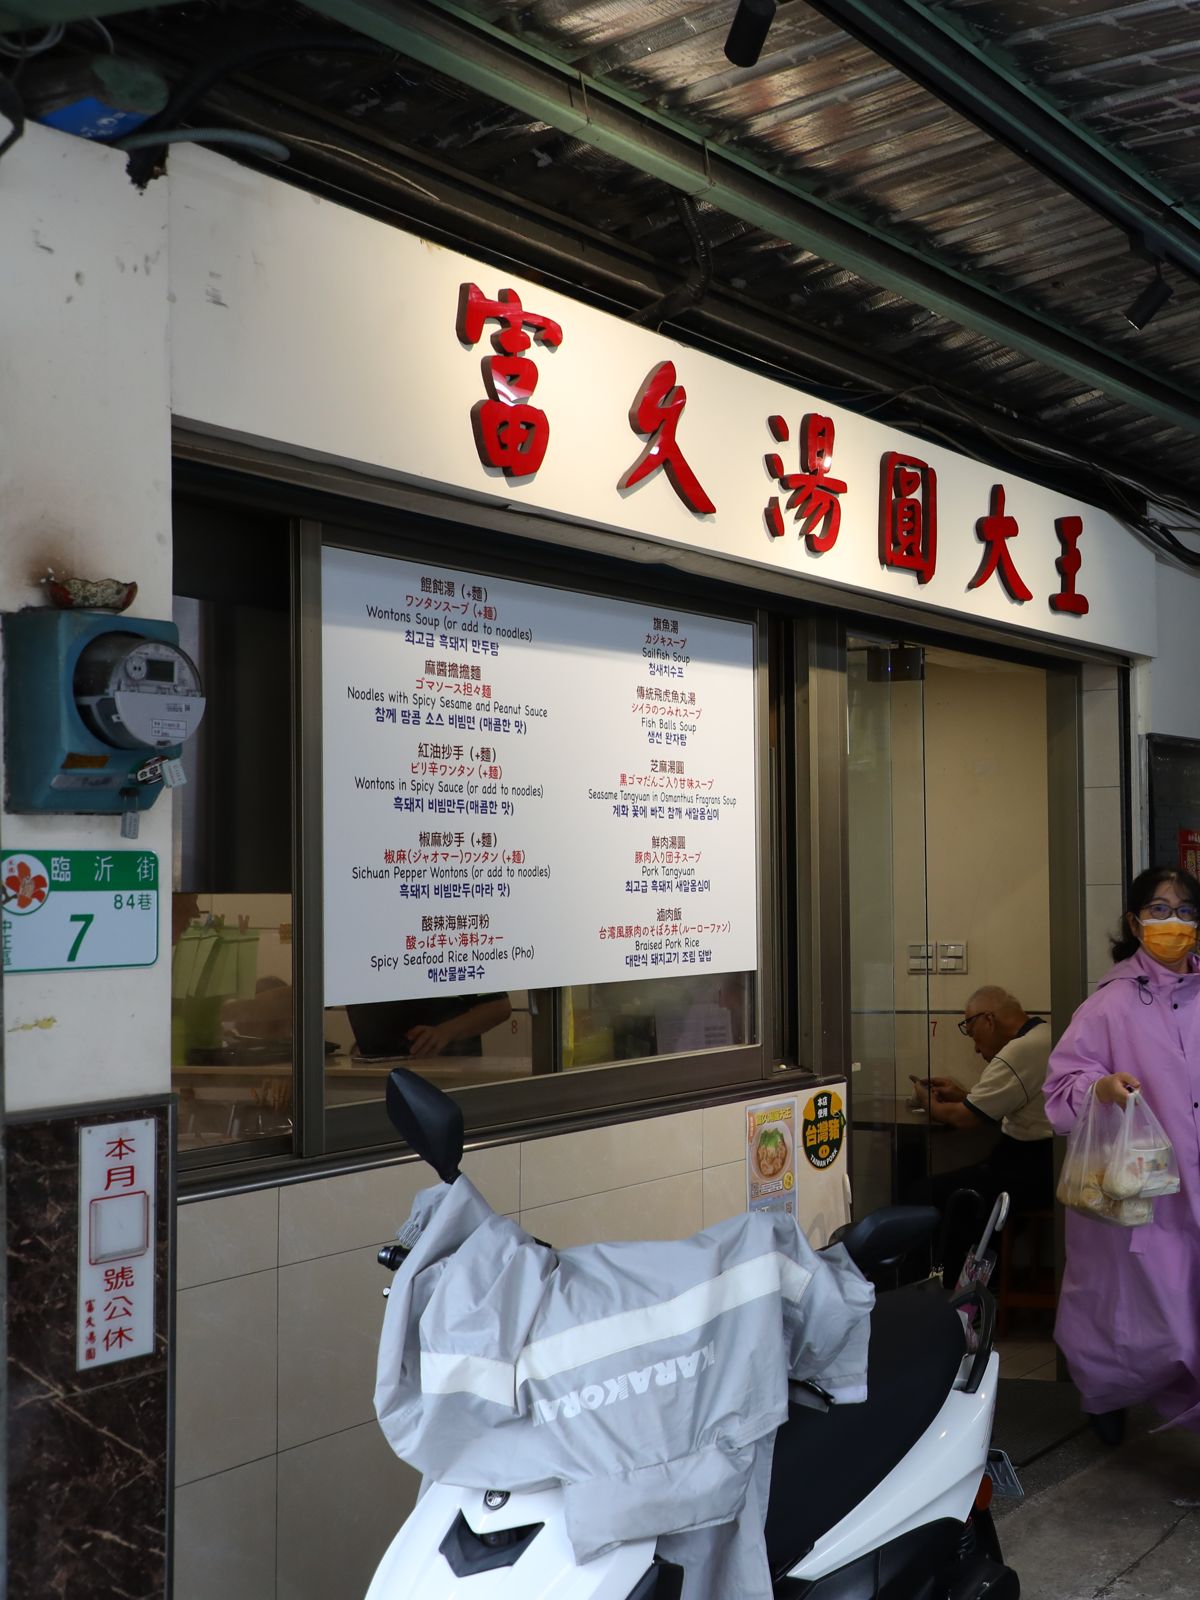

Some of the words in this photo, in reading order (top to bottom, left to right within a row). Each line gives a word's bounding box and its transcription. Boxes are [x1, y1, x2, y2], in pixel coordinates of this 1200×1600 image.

[455, 281, 1090, 616] 富久湯圓大王
[420, 576, 455, 598] 餛飩湯
[405, 595, 469, 615] ワンタンスープ
[366, 604, 411, 623] Wontons
[415, 614, 440, 628] Soup
[443, 616, 457, 631] (or
[461, 620, 478, 633] add
[483, 624, 492, 635] to
[495, 627, 533, 643] noodles)
[653, 616, 679, 634] 旗魚湯
[404, 629, 435, 648] 최고급
[439, 634, 468, 652] 흑돼지
[471, 639, 499, 657] 만두탕
[642, 647, 670, 661] Sailfish
[672, 652, 691, 666] Soup
[424, 660, 482, 681] 麻醬擔擔麵
[648, 663, 684, 678] 청새치수프
[347, 686, 385, 703] Noodles
[388, 691, 409, 704] with
[412, 694, 436, 710] Spicy
[439, 697, 472, 711] Sesame
[475, 701, 491, 712] and
[493, 702, 521, 715] Peanut
[525, 705, 548, 718] Sauce
[401, 710, 422, 726] 땅콩
[425, 712, 445, 726] 소스
[448, 713, 476, 731] 비빔면
[479, 717, 511, 733] (매콤한
[514, 720, 527, 735] 맛)
[641, 717, 656, 728] Fish
[659, 719, 677, 731] Balls
[679, 720, 697, 734] Soup
[647, 731, 663, 745] 생선
[665, 732, 687, 747] 완자탕
[418, 742, 464, 761] 紅油抄手
[650, 759, 685, 775] 芝麻湯圓
[354, 776, 395, 791] Wontons
[398, 778, 407, 791] in
[410, 779, 435, 796] Spicy
[438, 781, 464, 794] Sauce
[466, 780, 478, 796] (or
[481, 784, 497, 795] add
[501, 784, 509, 796] to
[511, 784, 544, 799] noodles)
[393, 796, 424, 813] 흑돼지
[501, 800, 514, 816] 맛)
[588, 788, 618, 801] Seasame
[620, 790, 650, 805] Tangyuan
[652, 792, 658, 801] in
[660, 791, 694, 804] Osmanthus
[695, 793, 721, 807] Fragrans
[722, 795, 737, 808] Soup
[612, 804, 629, 818] 계화
[631, 805, 648, 818] 꽃에
[650, 806, 665, 819] 빠진
[685, 807, 720, 821] 새알옹심이
[651, 835, 686, 850] 鮮肉湯圓
[51, 855, 156, 883] 臨沂街
[352, 866, 390, 879] Sichuan
[393, 866, 427, 882] Pepper
[430, 866, 469, 878] Wontons
[471, 865, 483, 880] (or
[487, 866, 503, 877] add
[506, 866, 515, 878] to
[517, 865, 551, 879] noodles)
[641, 865, 659, 877] Pork
[661, 865, 695, 879] Tangyuan
[399, 883, 430, 899] 흑돼지
[497, 882, 510, 898] 맛)
[625, 880, 648, 893] 최고급
[651, 880, 673, 893] 흑돼지
[675, 879, 711, 893] 새알옹심이
[113, 893, 152, 911] 84巷
[421, 913, 490, 932] 酸辣海鮮河粉
[656, 907, 683, 922] 滷肉飯
[66, 913, 95, 962] 7
[635, 938, 663, 951] Braised
[665, 938, 682, 950] Pork
[684, 938, 700, 948] Rice
[370, 955, 399, 971] Spicy
[403, 951, 444, 966] Seafood
[448, 950, 468, 963] Rice
[471, 947, 508, 962] Noodles
[511, 945, 535, 960] (Pho)
[625, 954, 648, 967] 대만식
[650, 951, 679, 966] 돼지고기
[682, 951, 696, 963] 조림
[427, 965, 485, 983] 해산물쌀국수
[817, 1107, 828, 1119] 使用
[104, 1136, 136, 1191] 本月
[810, 1153, 827, 1168] TAIWAN
[826, 1147, 839, 1165] PORK
[102, 1266, 135, 1353] 號公休
